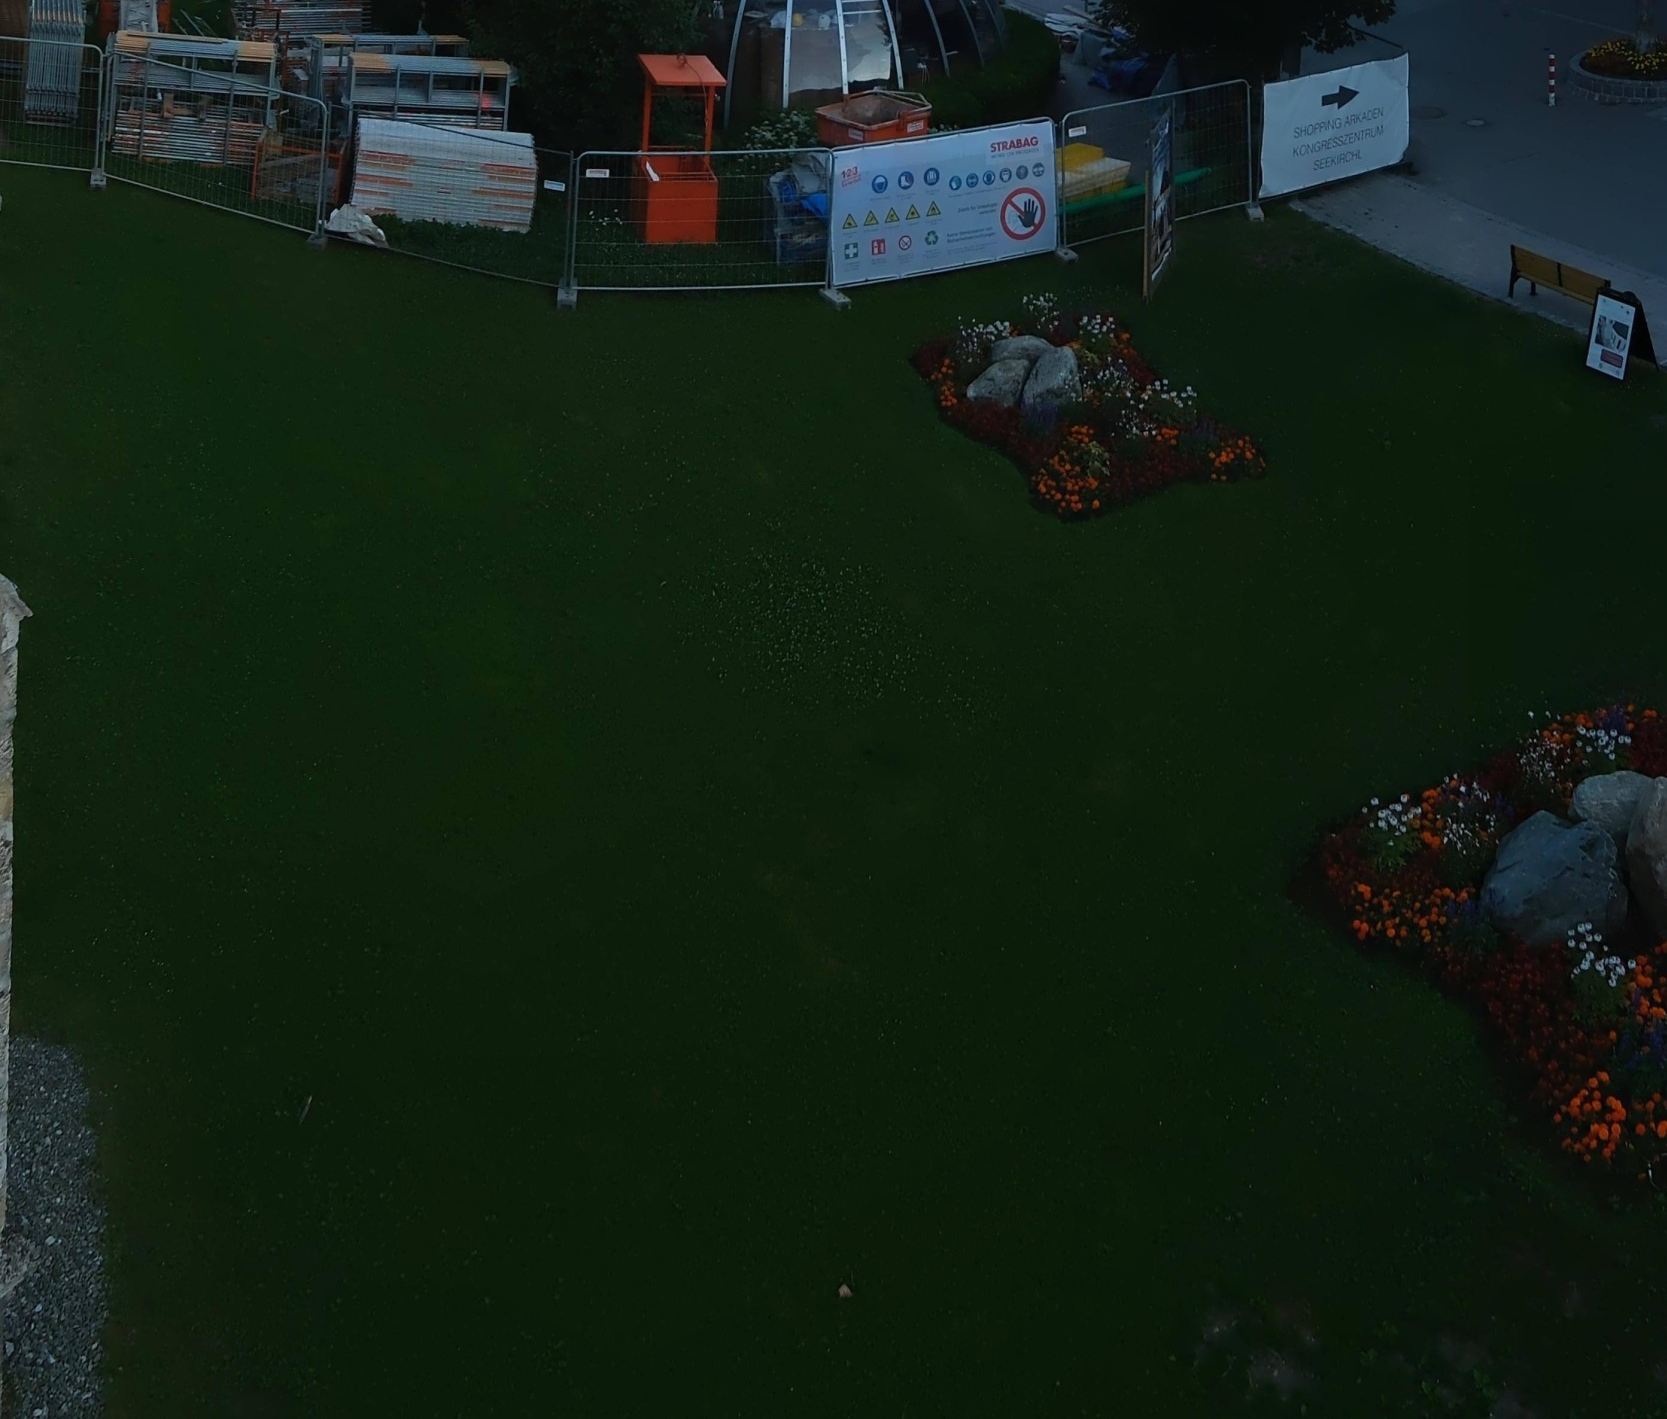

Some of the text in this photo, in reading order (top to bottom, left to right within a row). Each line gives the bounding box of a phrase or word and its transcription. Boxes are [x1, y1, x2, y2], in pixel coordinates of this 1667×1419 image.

[1293, 107, 1385, 139] SHOPPING ARKADEN
[990, 136, 1039, 152] STRABAG
[1292, 125, 1384, 158] KONGRESSZENTRUM
[1313, 149, 1362, 171] SEEKIRCHL
